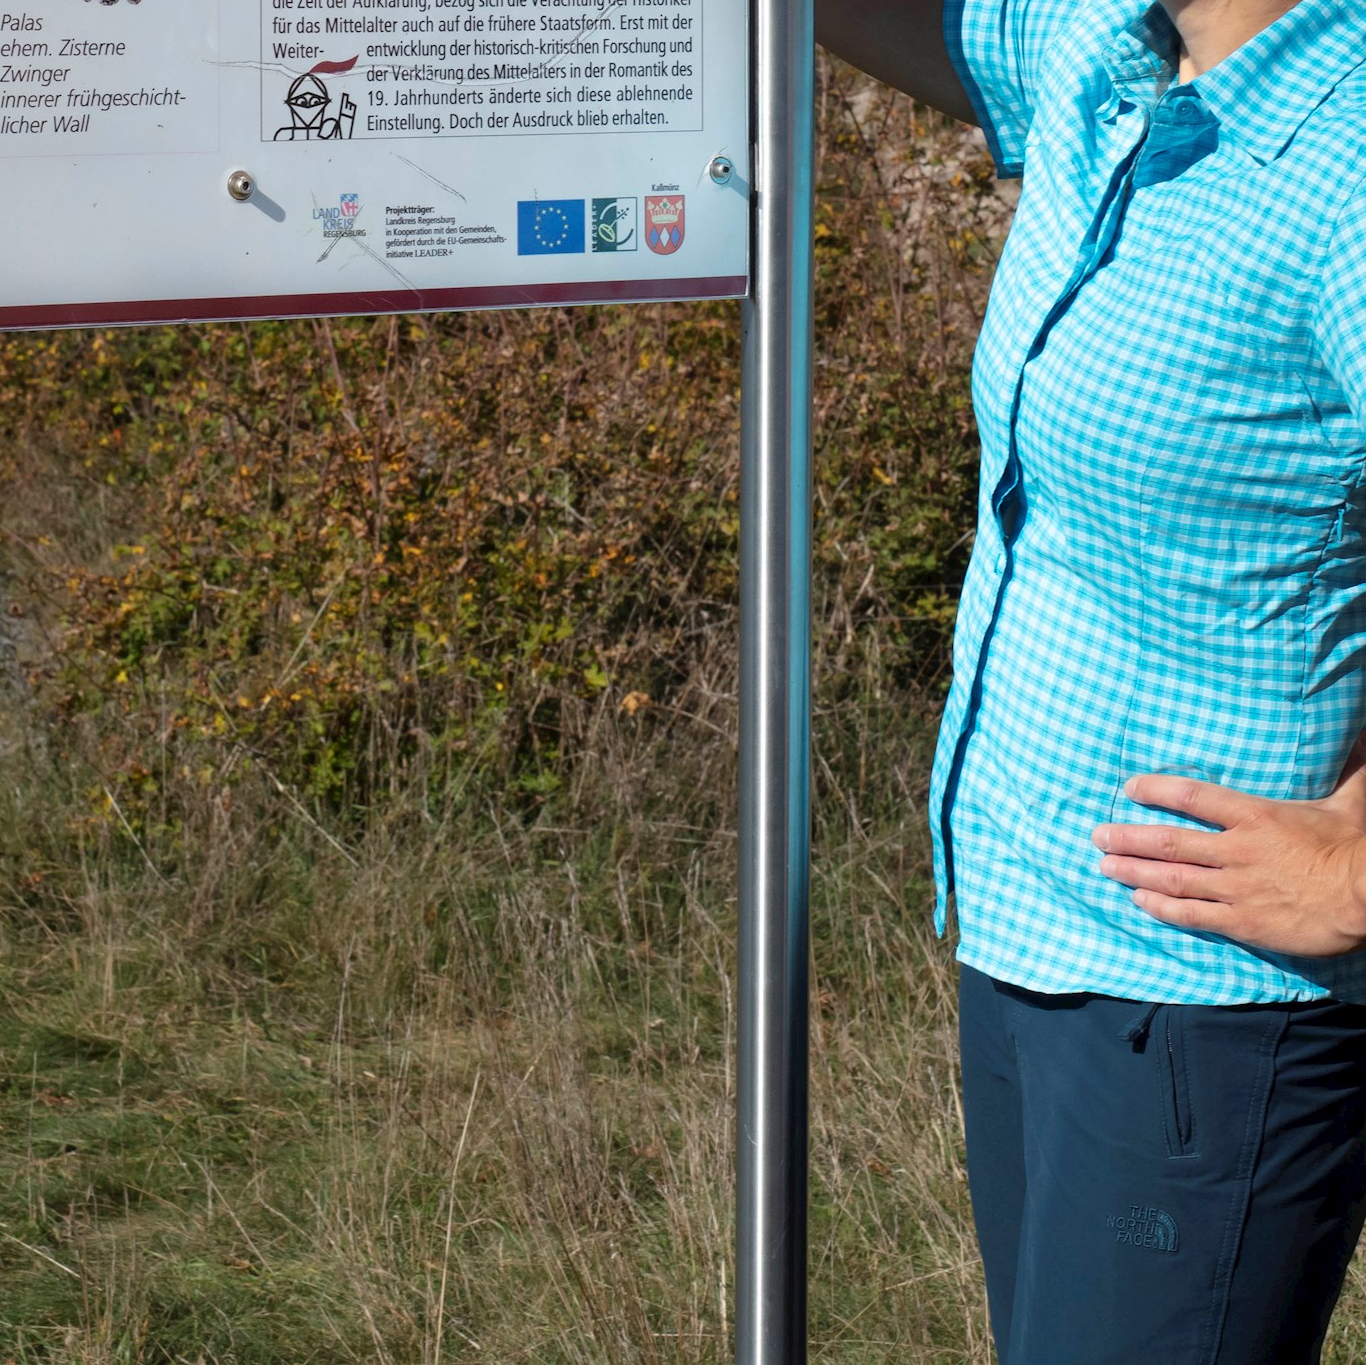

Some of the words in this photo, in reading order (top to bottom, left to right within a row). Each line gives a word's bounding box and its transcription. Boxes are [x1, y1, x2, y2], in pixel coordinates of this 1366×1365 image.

[0, 12, 43, 31] Palas
[0, 38, 52, 57] ehem.
[58, 38, 126, 56] Zisterne
[0, 64, 71, 86] Zwinger
[0, 90, 62, 108] innerer
[67, 87, 186, 111] frühgeschicht-
[367, 90, 388, 106] 19.
[393, 87, 483, 106] Jahrhunderts
[489, 86, 541, 104] änderte
[546, 85, 571, 103] sich
[576, 85, 611, 102] diese
[616, 83, 693, 101] ablehnende
[0, 115, 48, 134] licher
[53, 114, 90, 133] Wall
[651, 183, 680, 192] Kallmünz
[313, 208, 340, 219] LAND
[385, 205, 435, 216] Projektträger:
[385, 216, 416, 225] Landkreis
[417, 215, 456, 226] Regensburg
[393, 227, 432, 237] Kooperation
[445, 225, 458, 234] den
[458, 224, 497, 234] Gemeinden,
[385, 238, 415, 249] gefördert
[416, 237, 435, 246] durch
[414, 248, 453, 258] LEADER+
[1129, 1205, 1157, 1221] THE
[1106, 1215, 1155, 1234] NORTH
[1116, 1231, 1153, 1248] FACE
